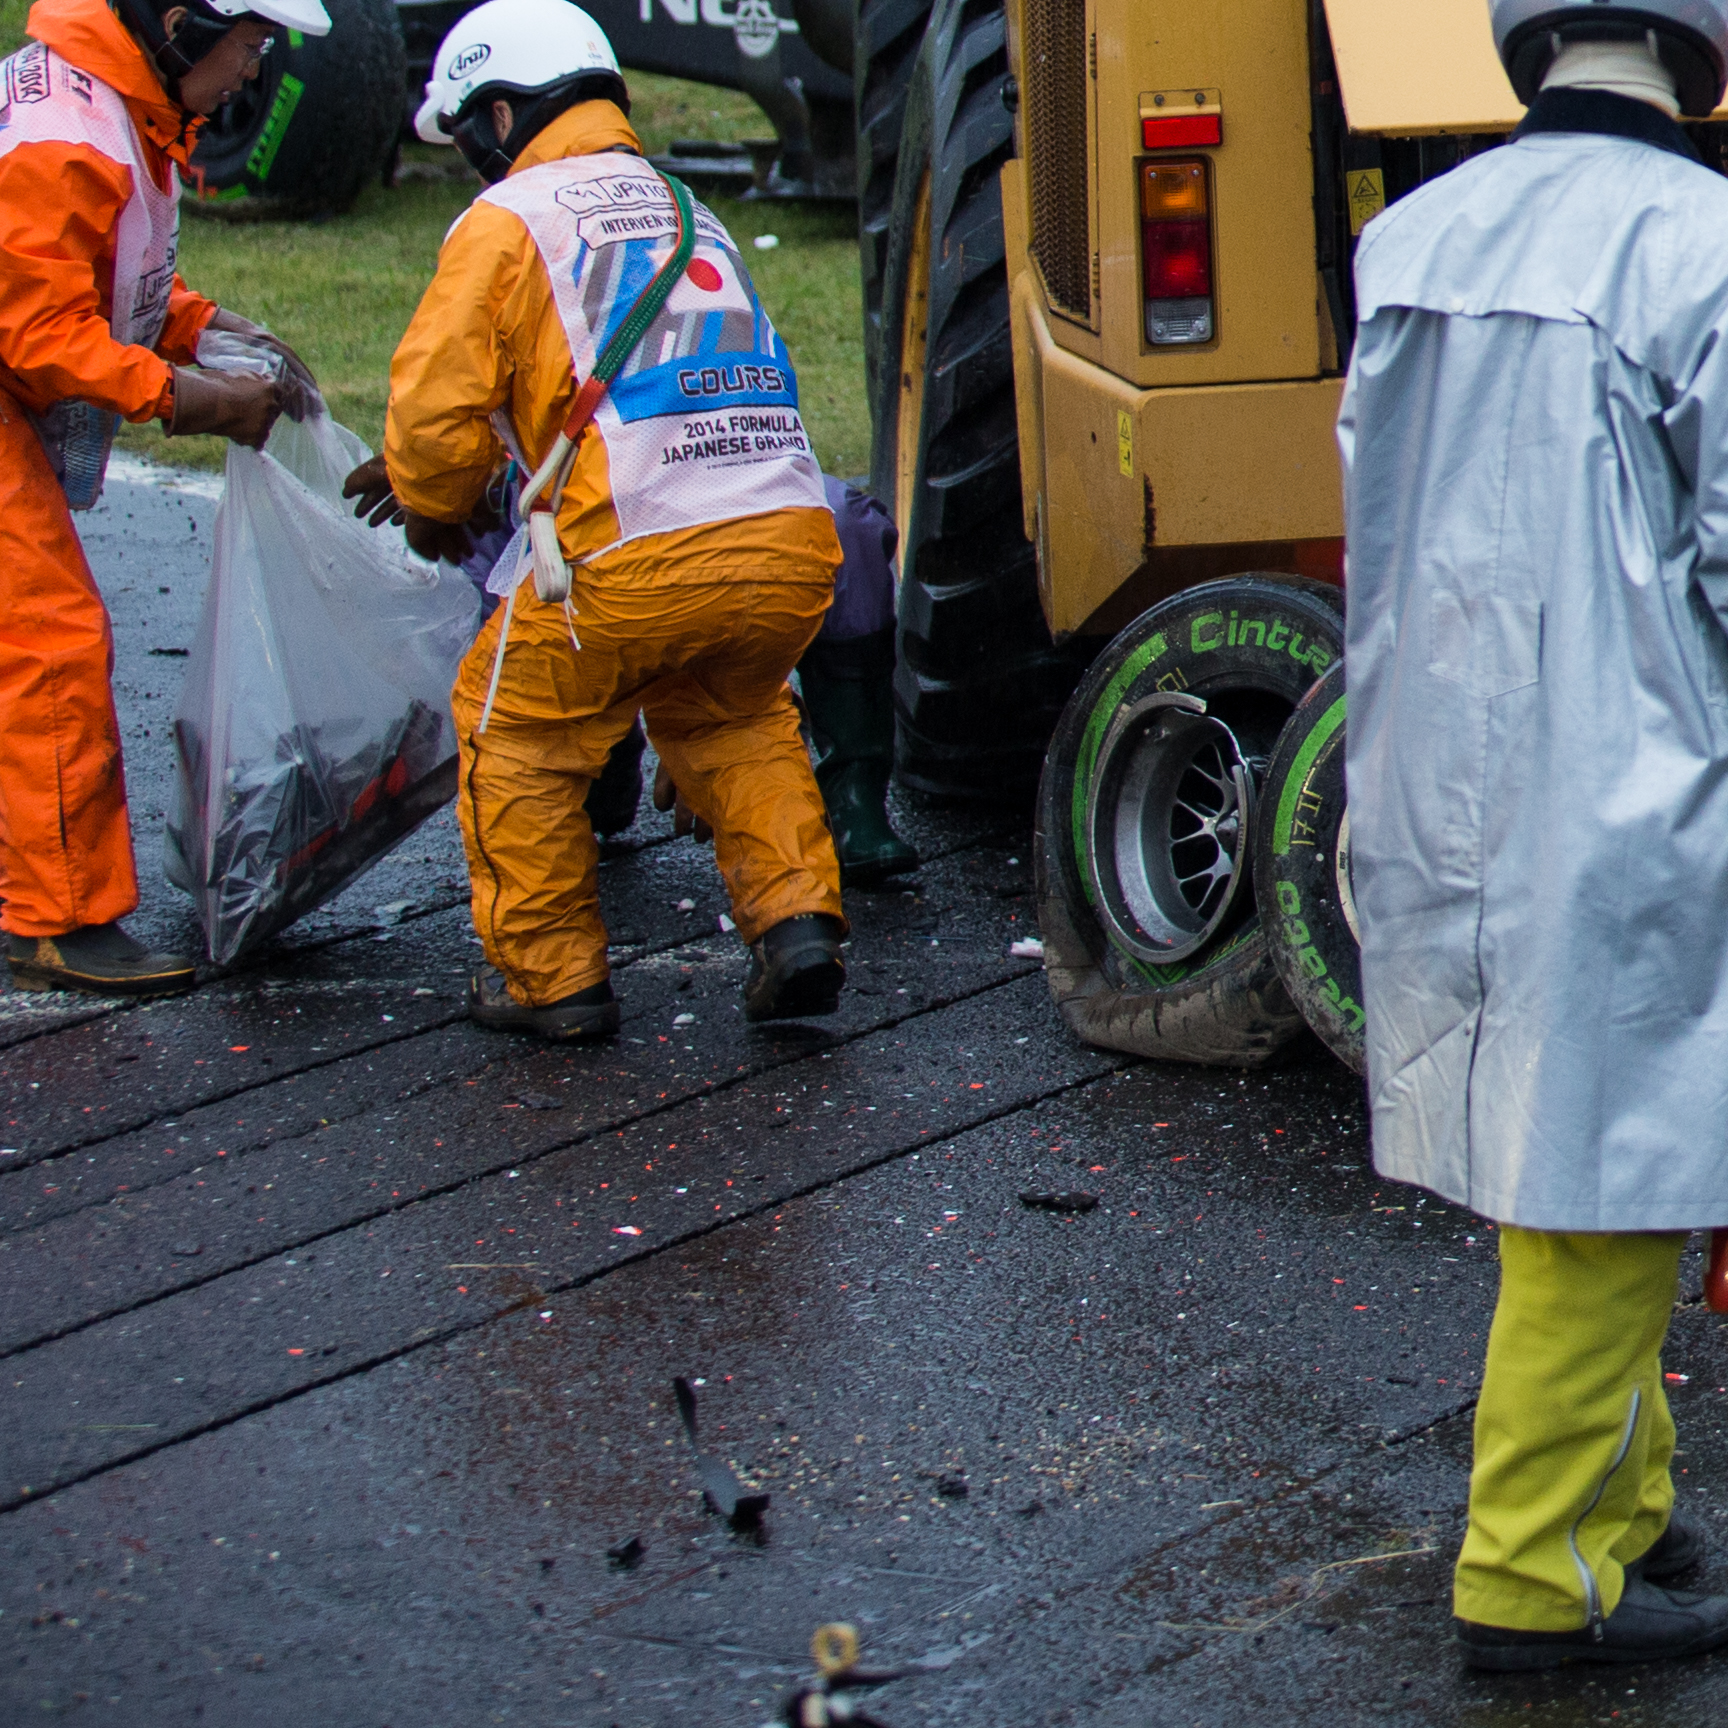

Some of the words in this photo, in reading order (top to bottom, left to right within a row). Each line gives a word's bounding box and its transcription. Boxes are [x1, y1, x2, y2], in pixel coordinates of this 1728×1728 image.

[678, 365, 790, 398] COURS
[684, 418, 727, 439] 2014
[729, 416, 803, 434] FORMULA
[661, 436, 752, 465] JAPANESE
